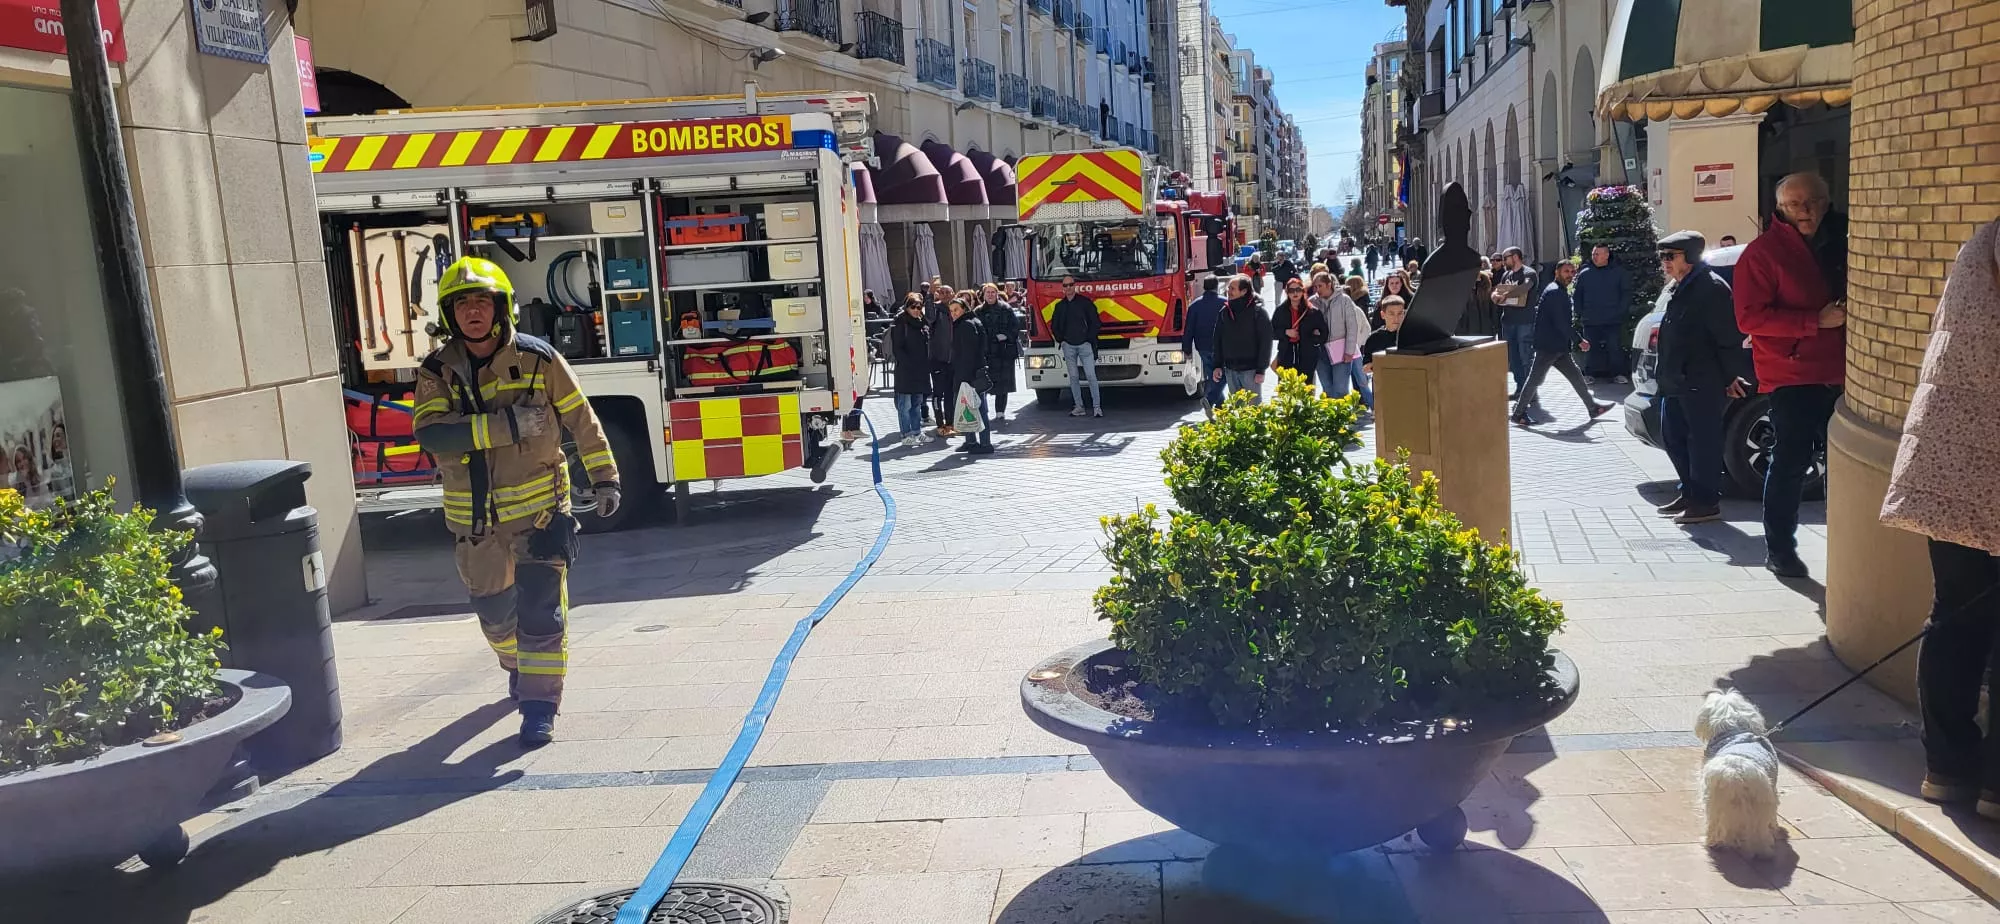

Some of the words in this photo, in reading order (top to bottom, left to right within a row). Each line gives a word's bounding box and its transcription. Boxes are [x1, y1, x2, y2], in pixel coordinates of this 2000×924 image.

[205, 24, 261, 51] VILLAHERMOSA
[632, 122, 780, 153] BOMBEROS
[1095, 282, 1144, 292] MAGIRUS
